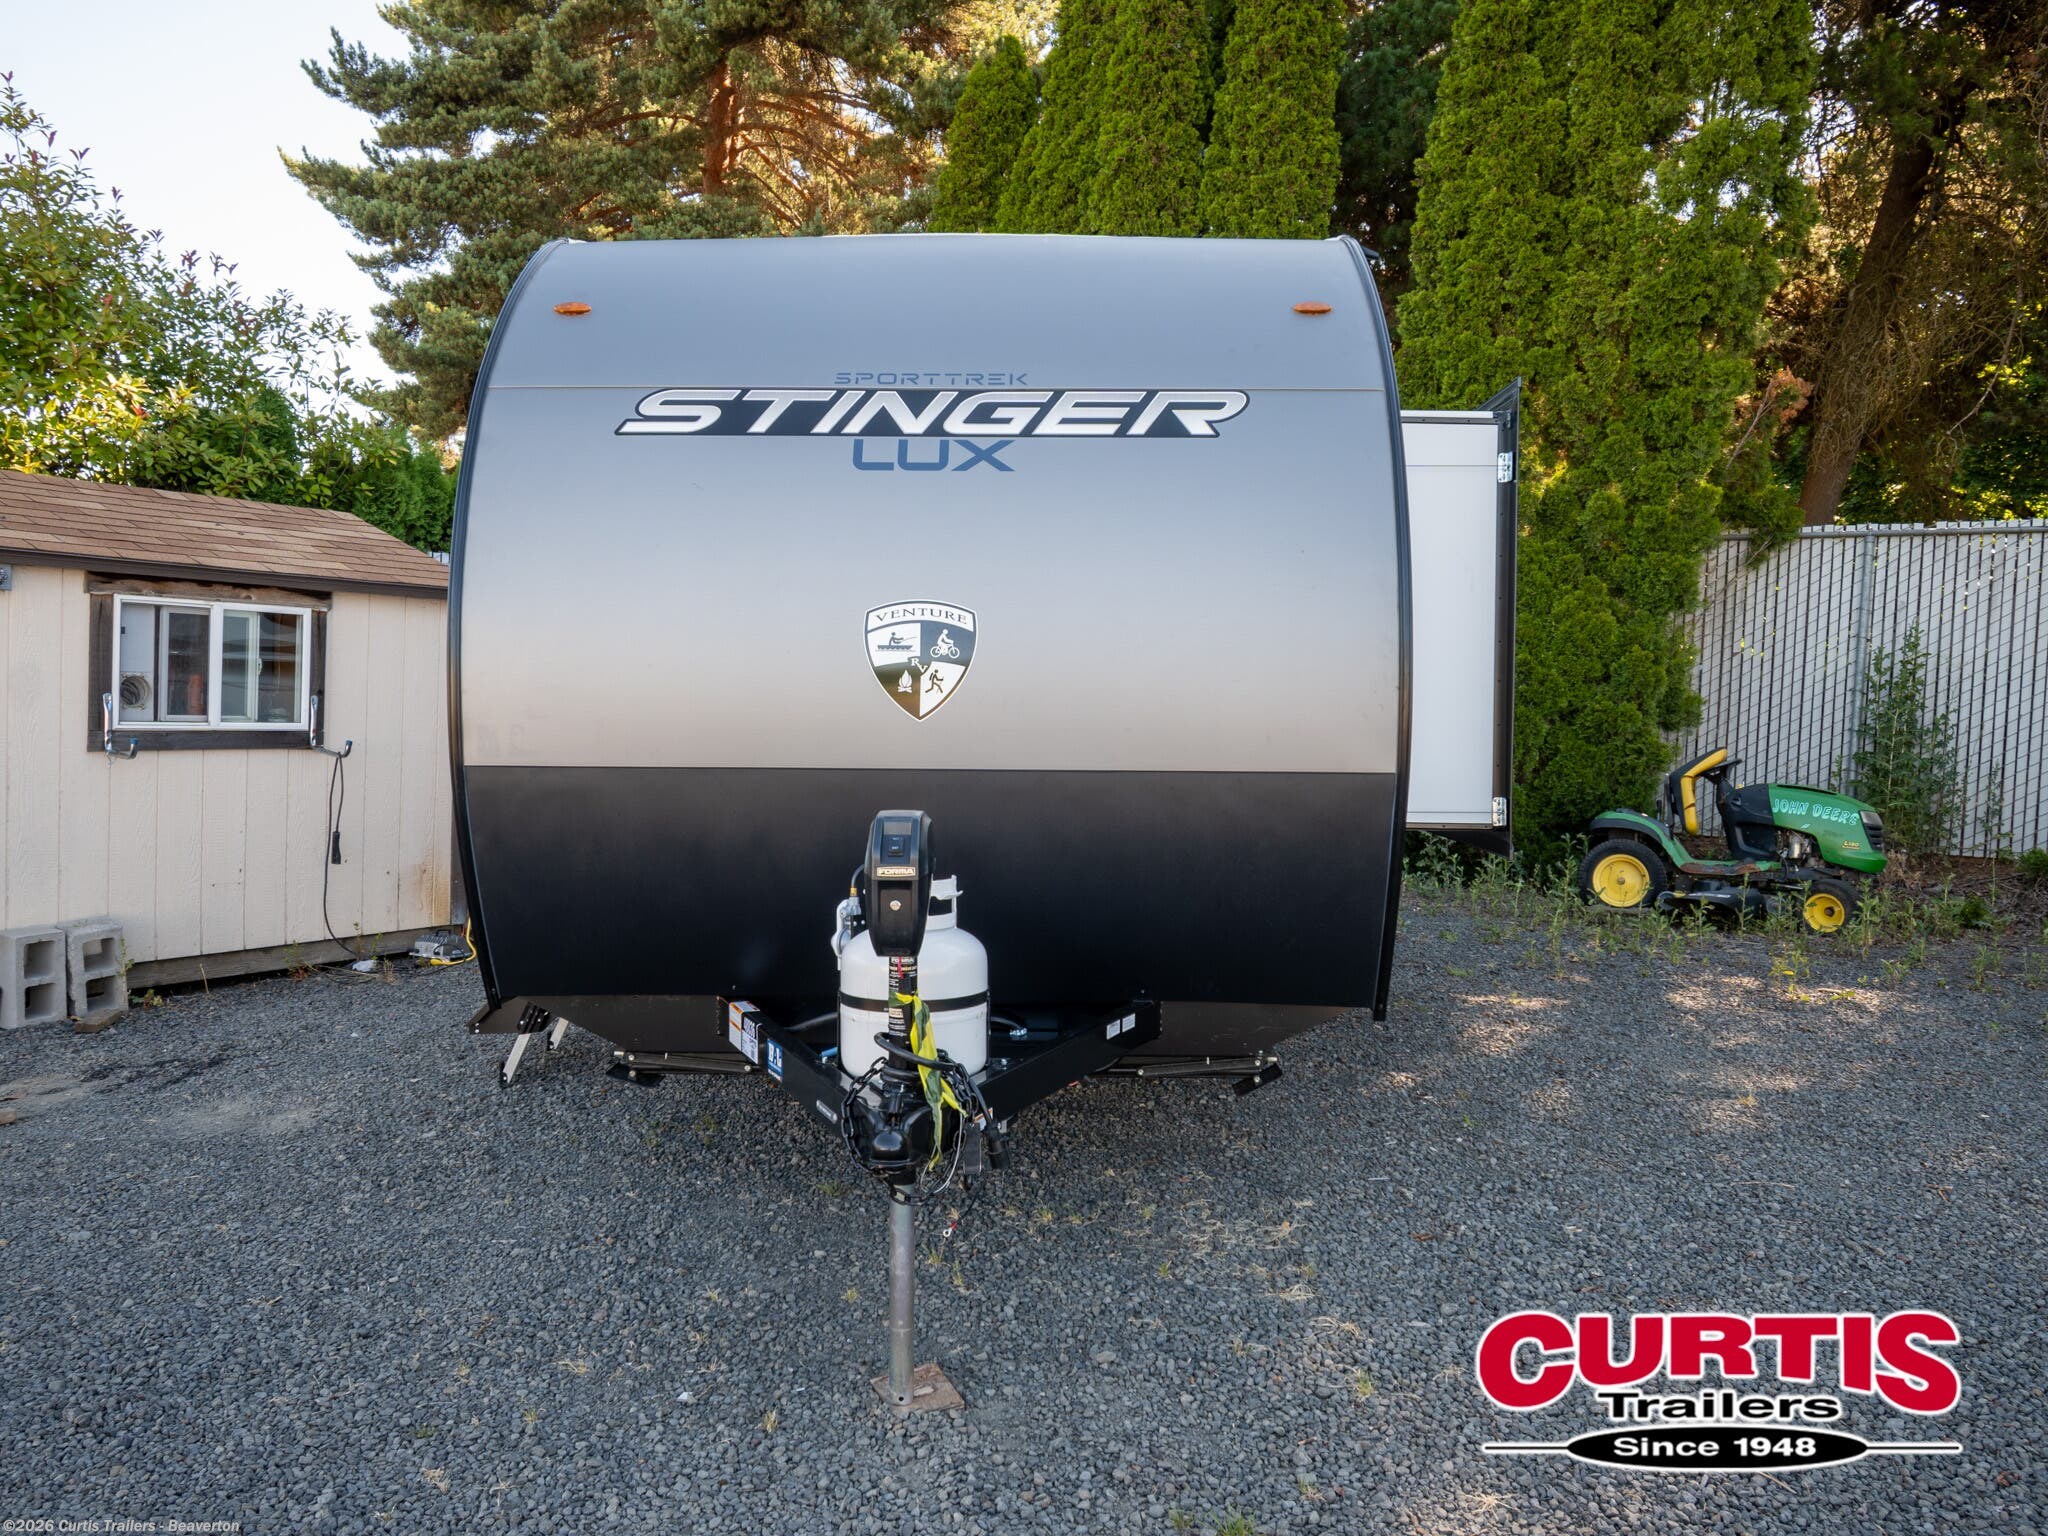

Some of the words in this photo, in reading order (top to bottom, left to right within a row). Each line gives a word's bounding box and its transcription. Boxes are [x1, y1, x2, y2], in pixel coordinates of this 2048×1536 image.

[834, 373, 1029, 386] SPORTTREK
[619, 388, 1247, 436] STINGER
[852, 438, 1016, 473] LUX
[875, 607, 967, 625] VENTURE
[1772, 798, 1809, 816] JOHN
[878, 867, 915, 876] FORMA
